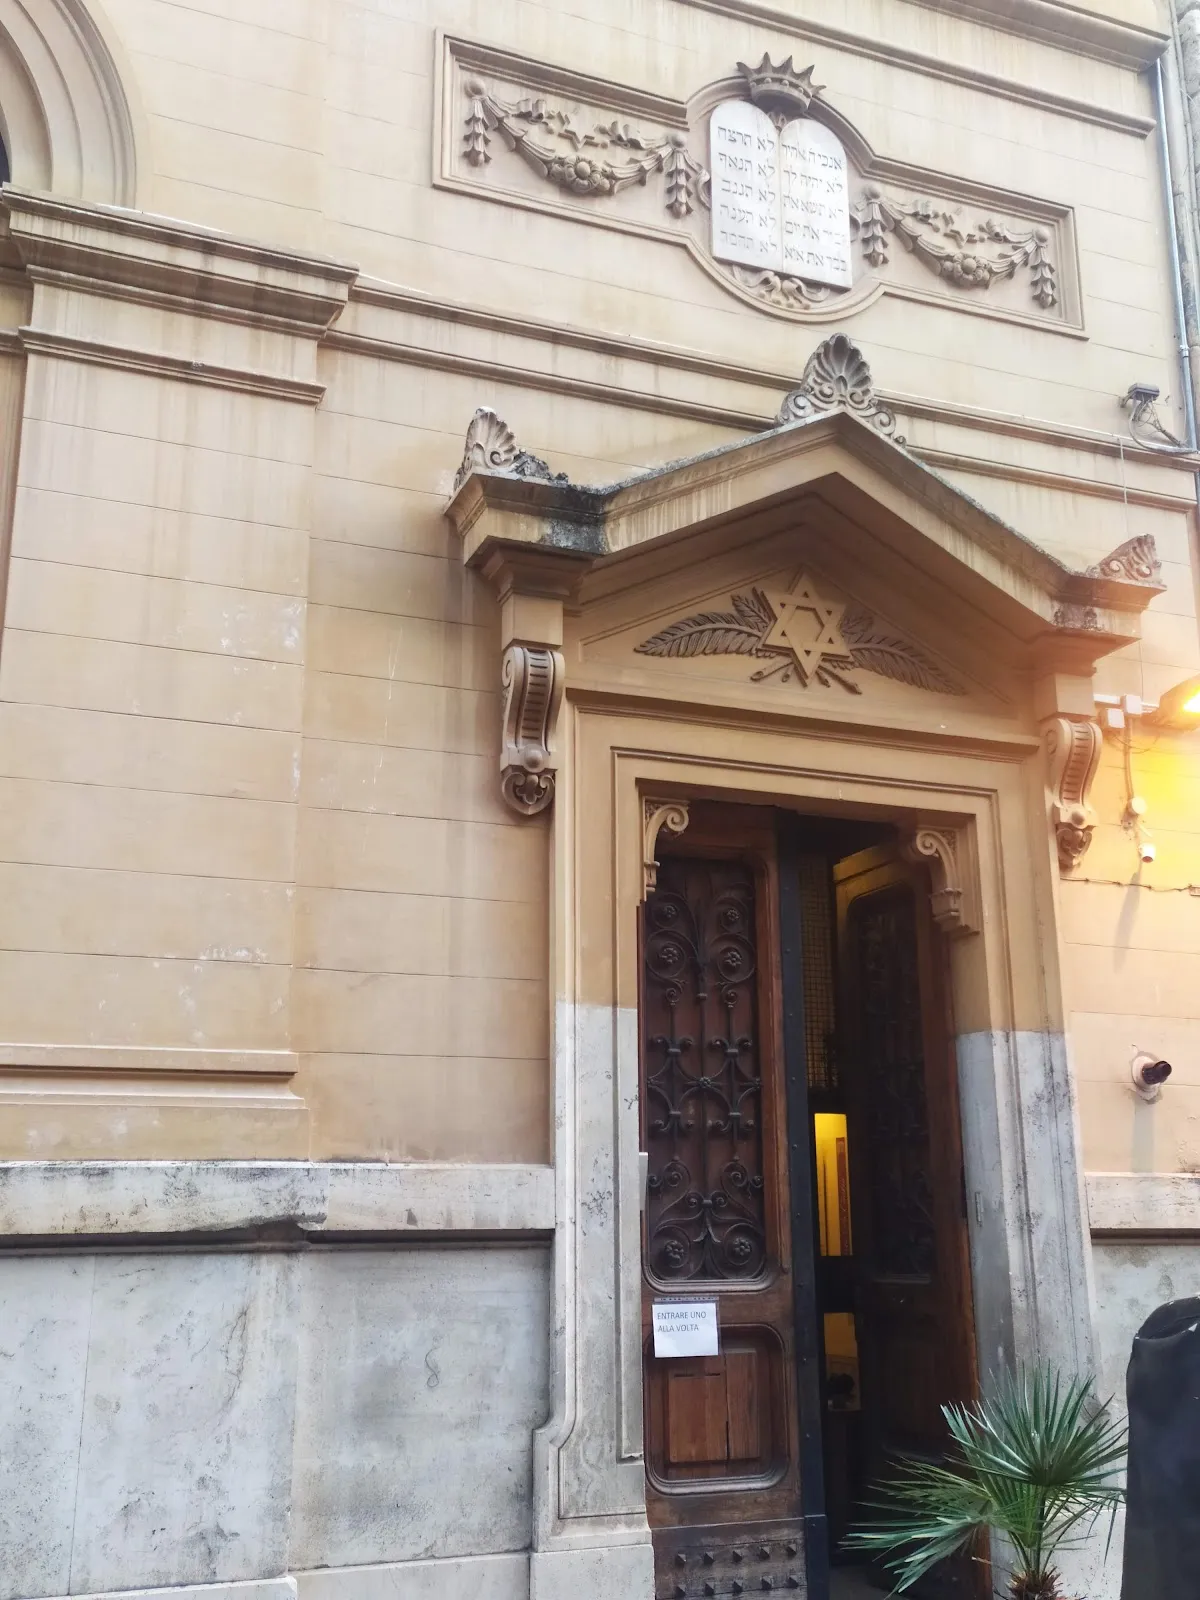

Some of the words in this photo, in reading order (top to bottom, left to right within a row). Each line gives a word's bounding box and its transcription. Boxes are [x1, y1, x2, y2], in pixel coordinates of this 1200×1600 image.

[757, 133, 775, 151] לא
[757, 158, 775, 177] לא
[758, 184, 776, 203] לא
[759, 208, 776, 229] לא
[760, 235, 777, 253] לא
